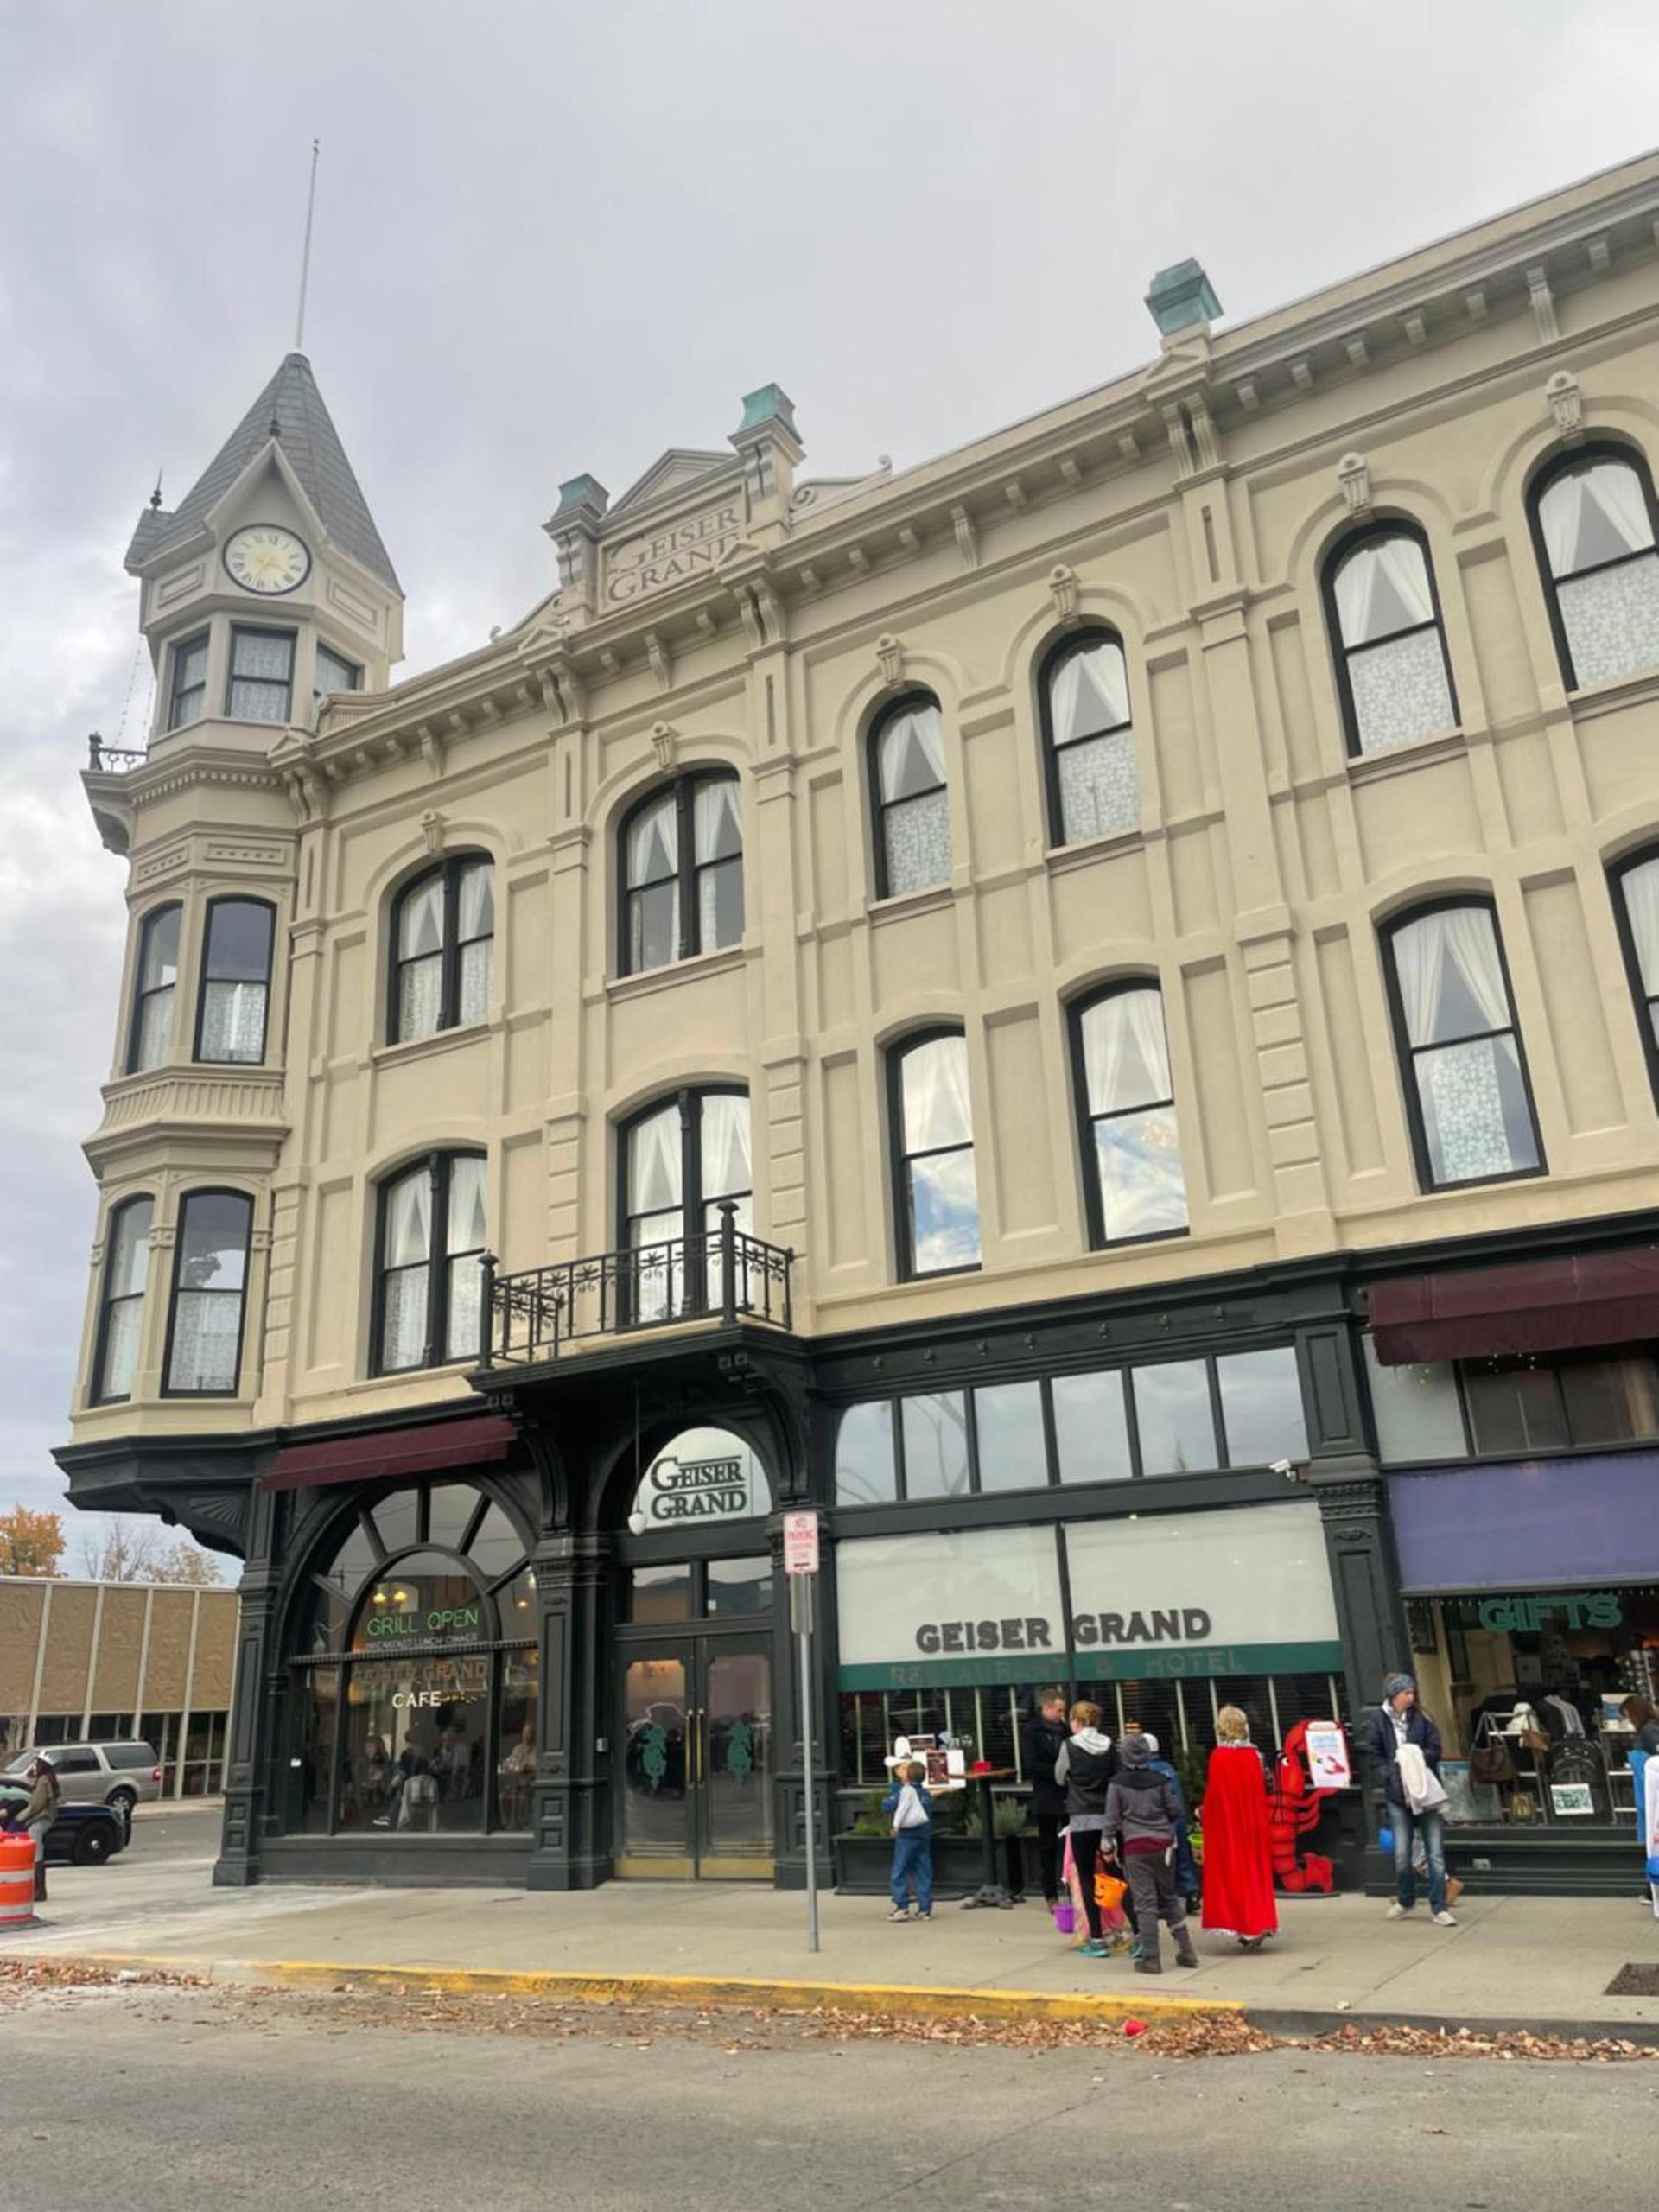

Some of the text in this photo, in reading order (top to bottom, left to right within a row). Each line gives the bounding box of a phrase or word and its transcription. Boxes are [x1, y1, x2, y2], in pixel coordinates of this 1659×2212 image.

[650, 1456, 745, 1491] GEISER
[651, 1491, 747, 1520] GRAND
[366, 1608, 479, 1636] GRILL OPEN
[1478, 1593, 1623, 1633] GIFTS
[916, 1608, 1211, 1653] GEISER GRAND
[423, 1659, 487, 1681] GRAND
[1146, 1650, 1248, 1676] HOTEL
[391, 1691, 442, 1708] CAFE
